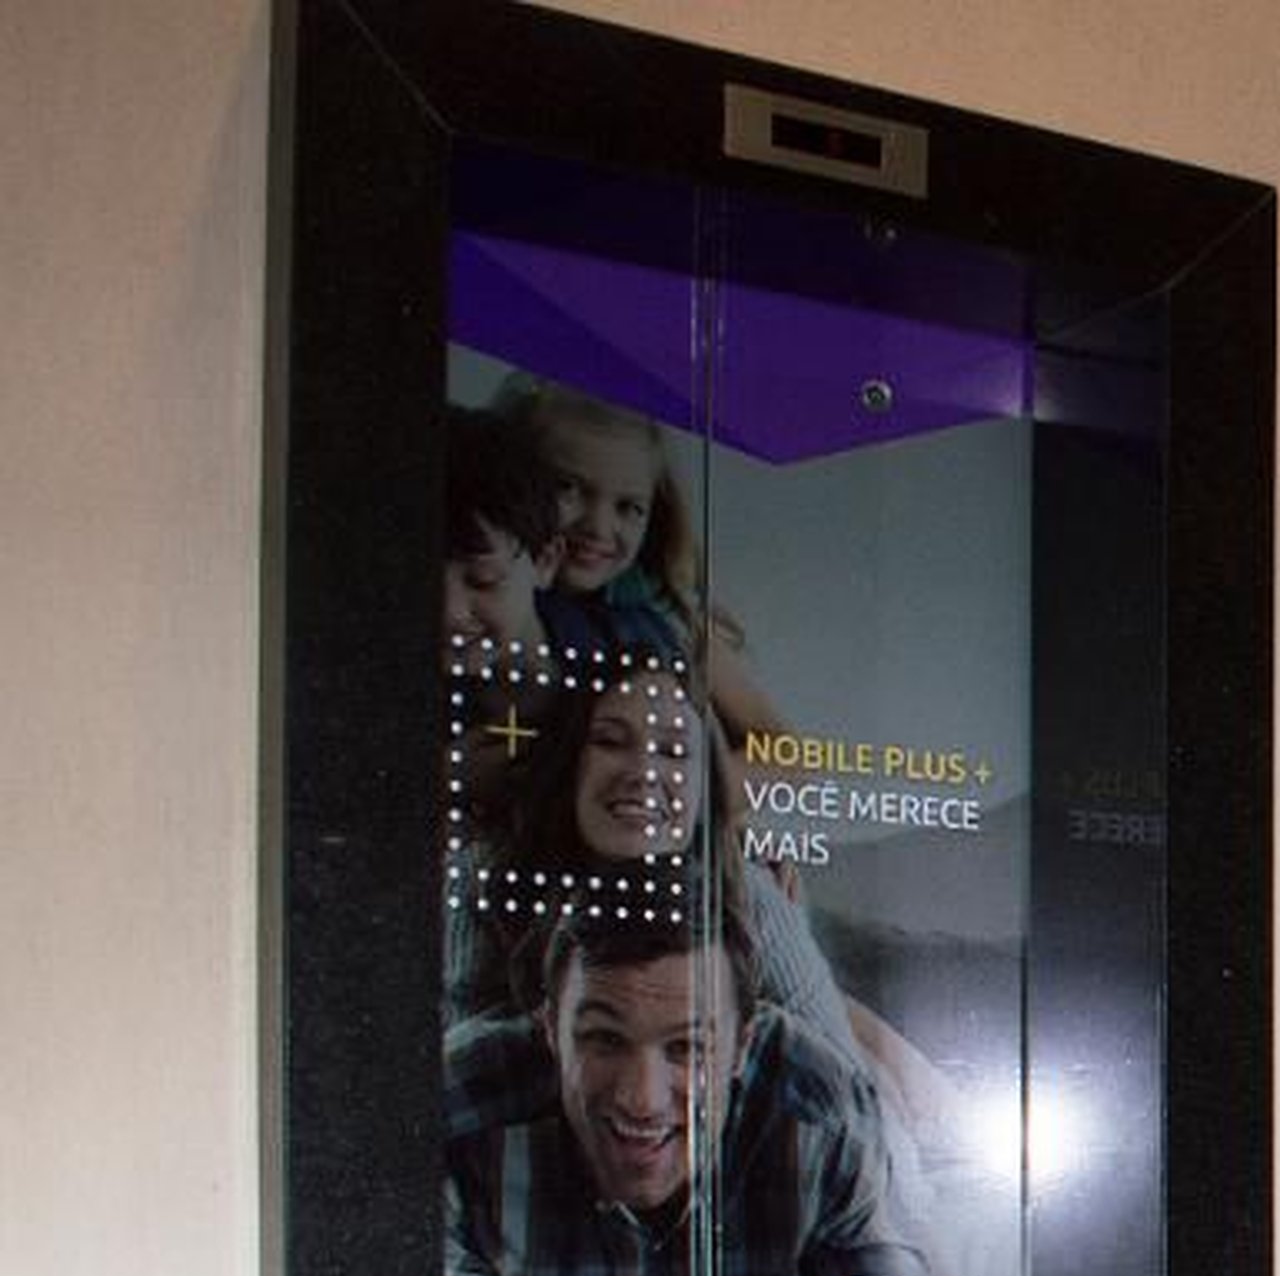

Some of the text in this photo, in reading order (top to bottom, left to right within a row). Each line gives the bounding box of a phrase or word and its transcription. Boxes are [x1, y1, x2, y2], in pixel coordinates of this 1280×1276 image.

[745, 731, 873, 774] NOBILE
[883, 745, 967, 783] PLUS
[744, 779, 981, 831] VOCÊ MERECE
[743, 827, 830, 866] MAIS
